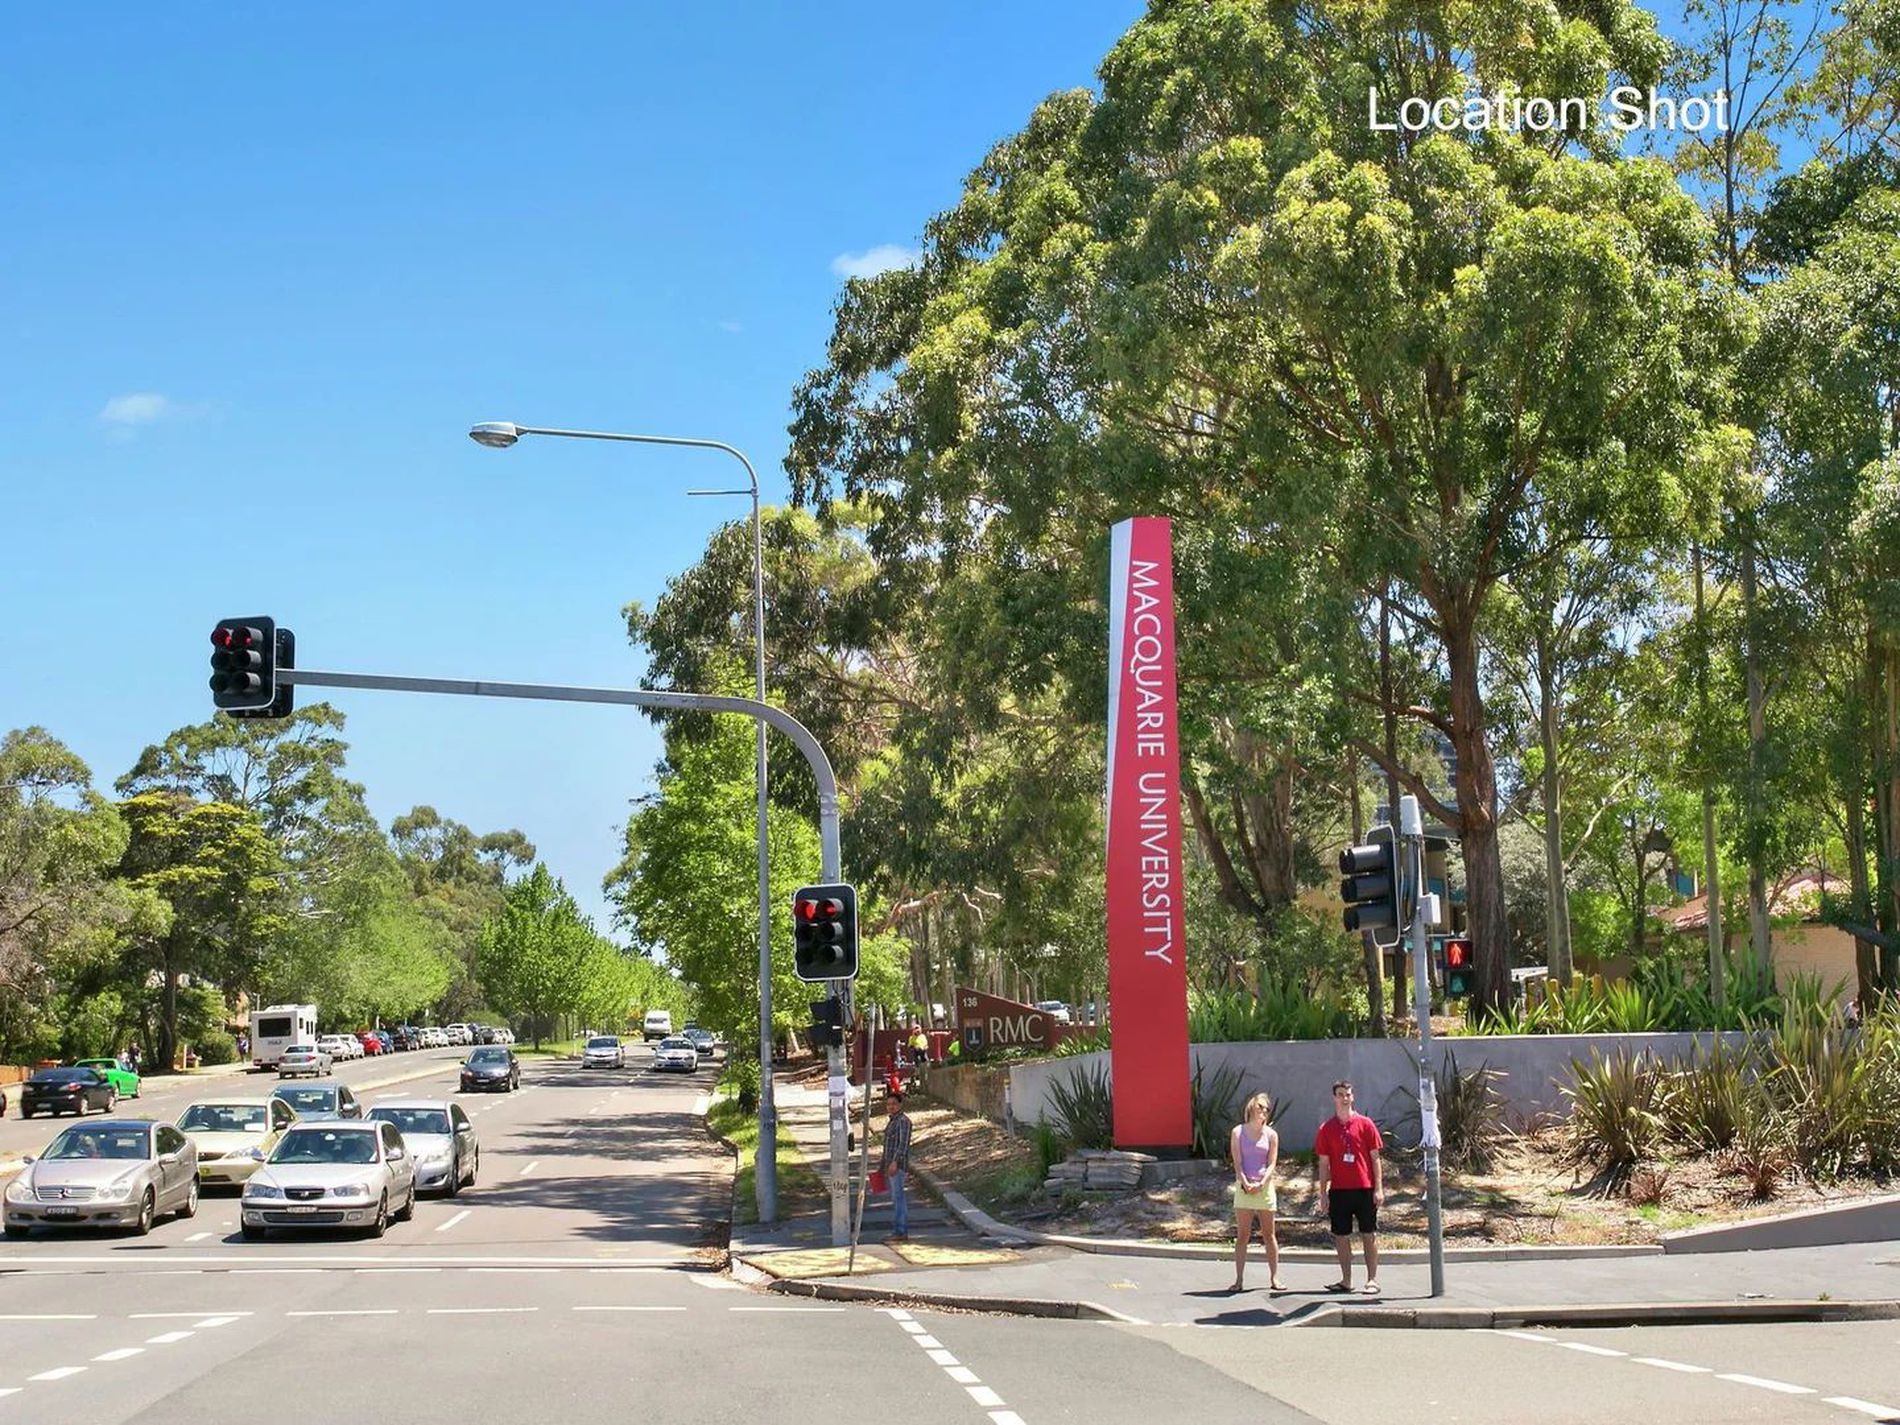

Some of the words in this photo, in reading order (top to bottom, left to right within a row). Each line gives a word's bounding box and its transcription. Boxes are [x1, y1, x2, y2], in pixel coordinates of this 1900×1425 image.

[1130, 559, 1165, 757] MACQUARIE
[1137, 771, 1173, 965] UNIVERSITY
[989, 1013, 1045, 1043] RMC
